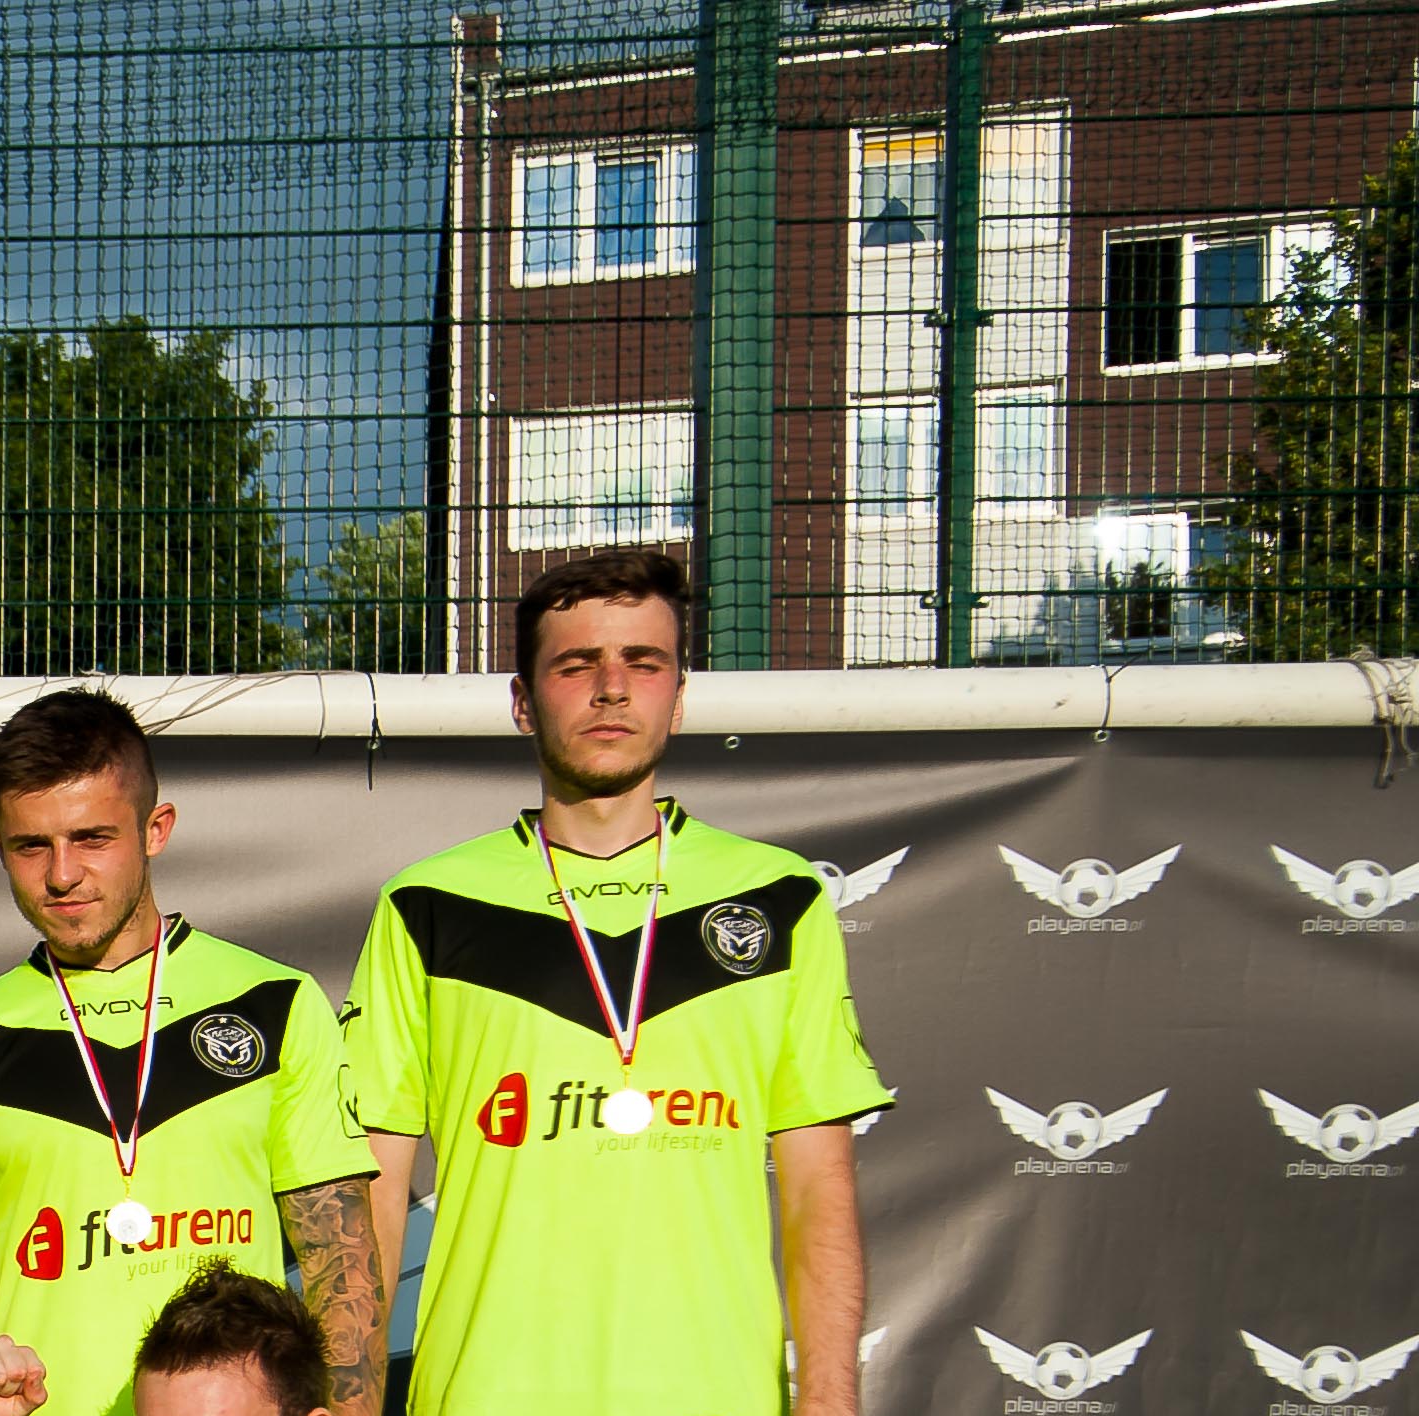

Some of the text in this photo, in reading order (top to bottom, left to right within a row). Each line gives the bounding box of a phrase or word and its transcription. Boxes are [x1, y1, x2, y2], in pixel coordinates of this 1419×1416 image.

[547, 882, 669, 905] GIVOVA
[60, 996, 173, 1021] GIVOVA
[542, 1081, 740, 1141] fitren
[595, 1137, 639, 1155] your
[78, 1209, 252, 1271] fiarena
[128, 1259, 168, 1281] your
